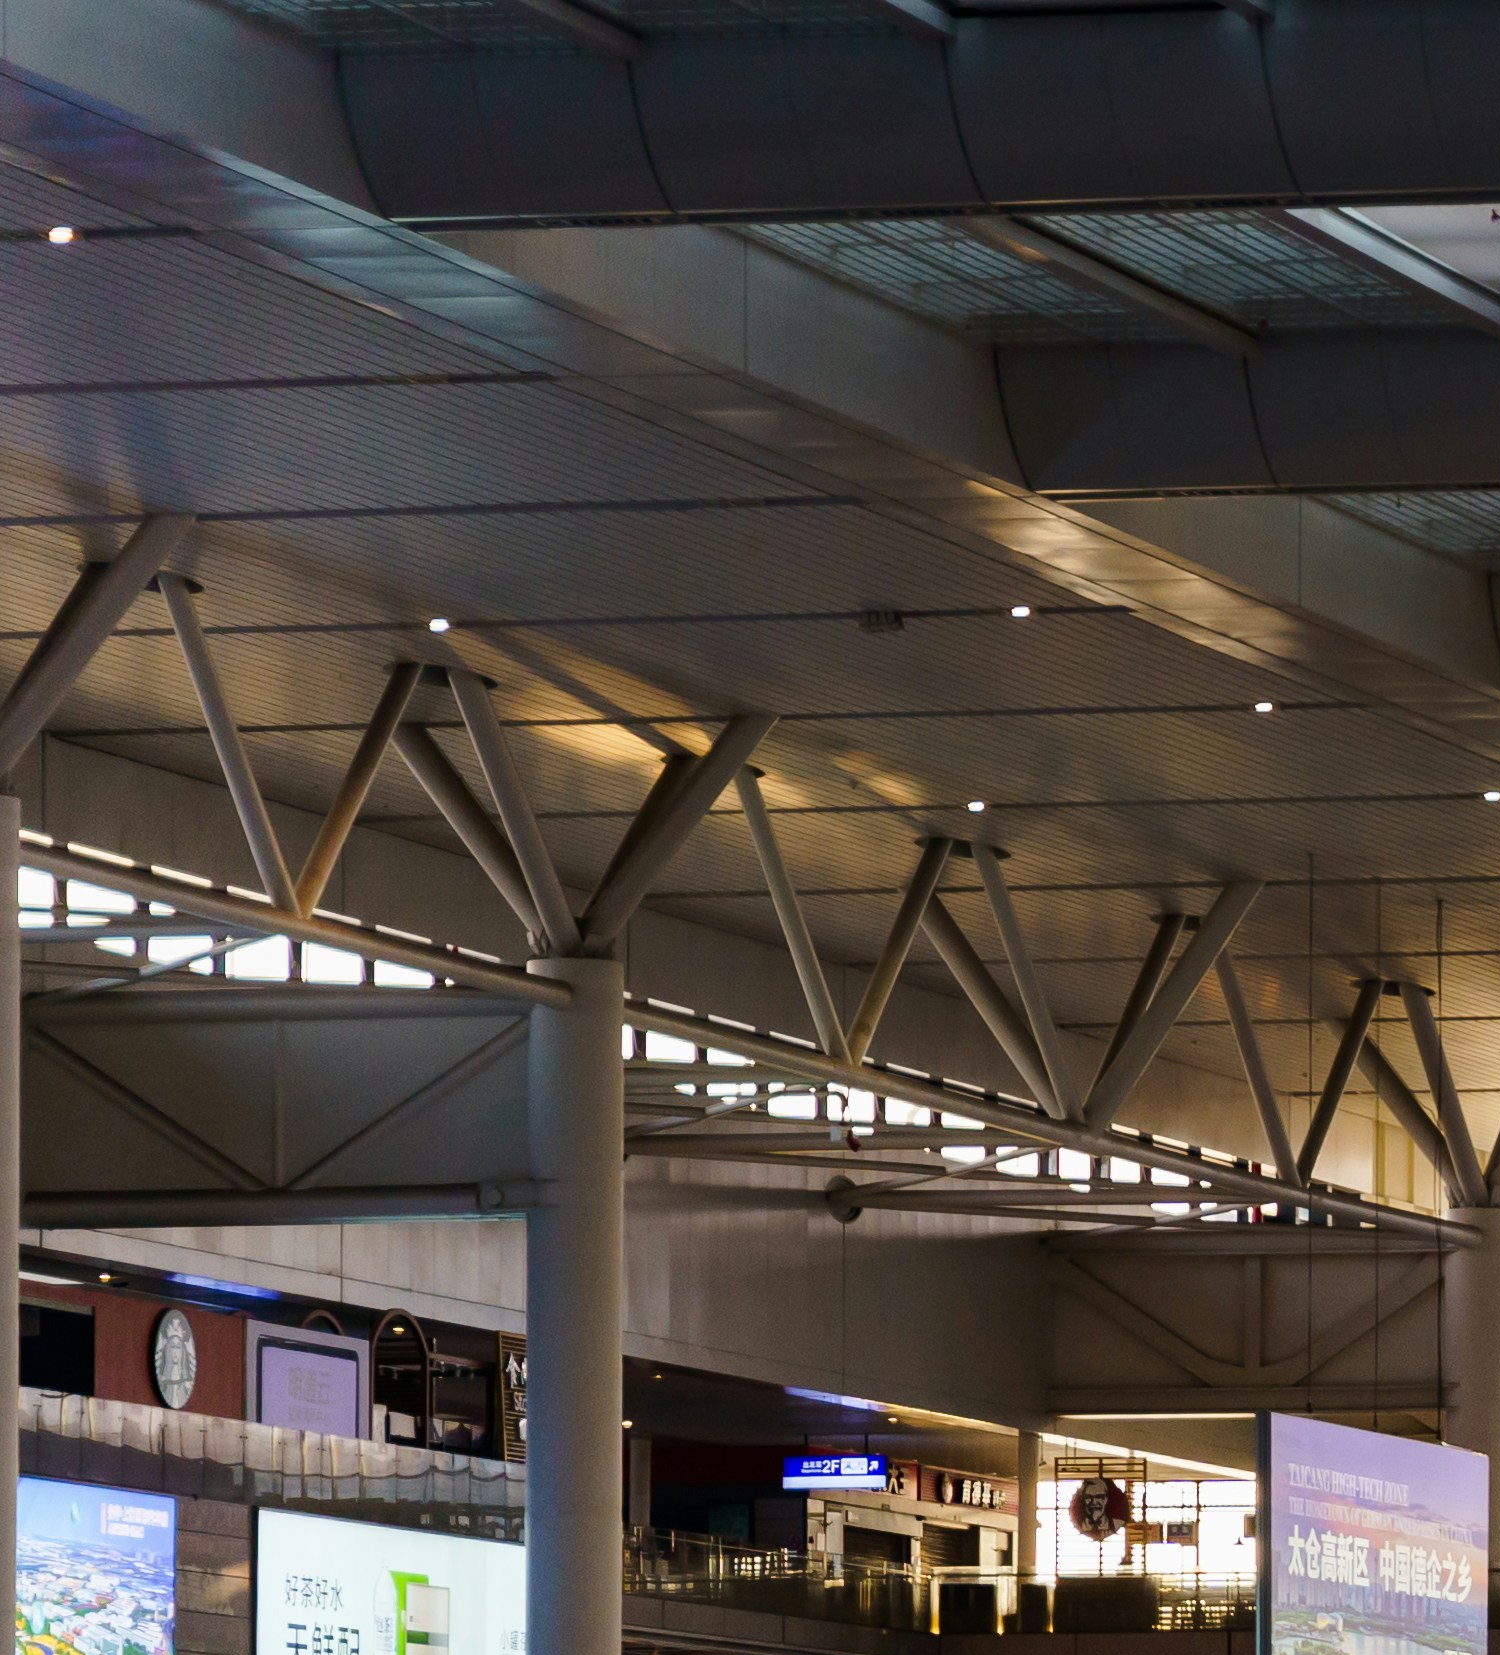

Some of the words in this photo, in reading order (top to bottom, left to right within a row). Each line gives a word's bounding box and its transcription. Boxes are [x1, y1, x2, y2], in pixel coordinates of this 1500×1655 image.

[822, 1459, 841, 1474] 2F
[1288, 1463, 1330, 1493] TAICANG
[1332, 1469, 1384, 1502] HIGH-TECH
[1384, 1482, 1409, 1507] ZONE
[1288, 1525, 1370, 1588] 太仓高新区
[1379, 1540, 1473, 1603] 中国德企之乡
[284, 1574, 343, 1612] 好茶好水
